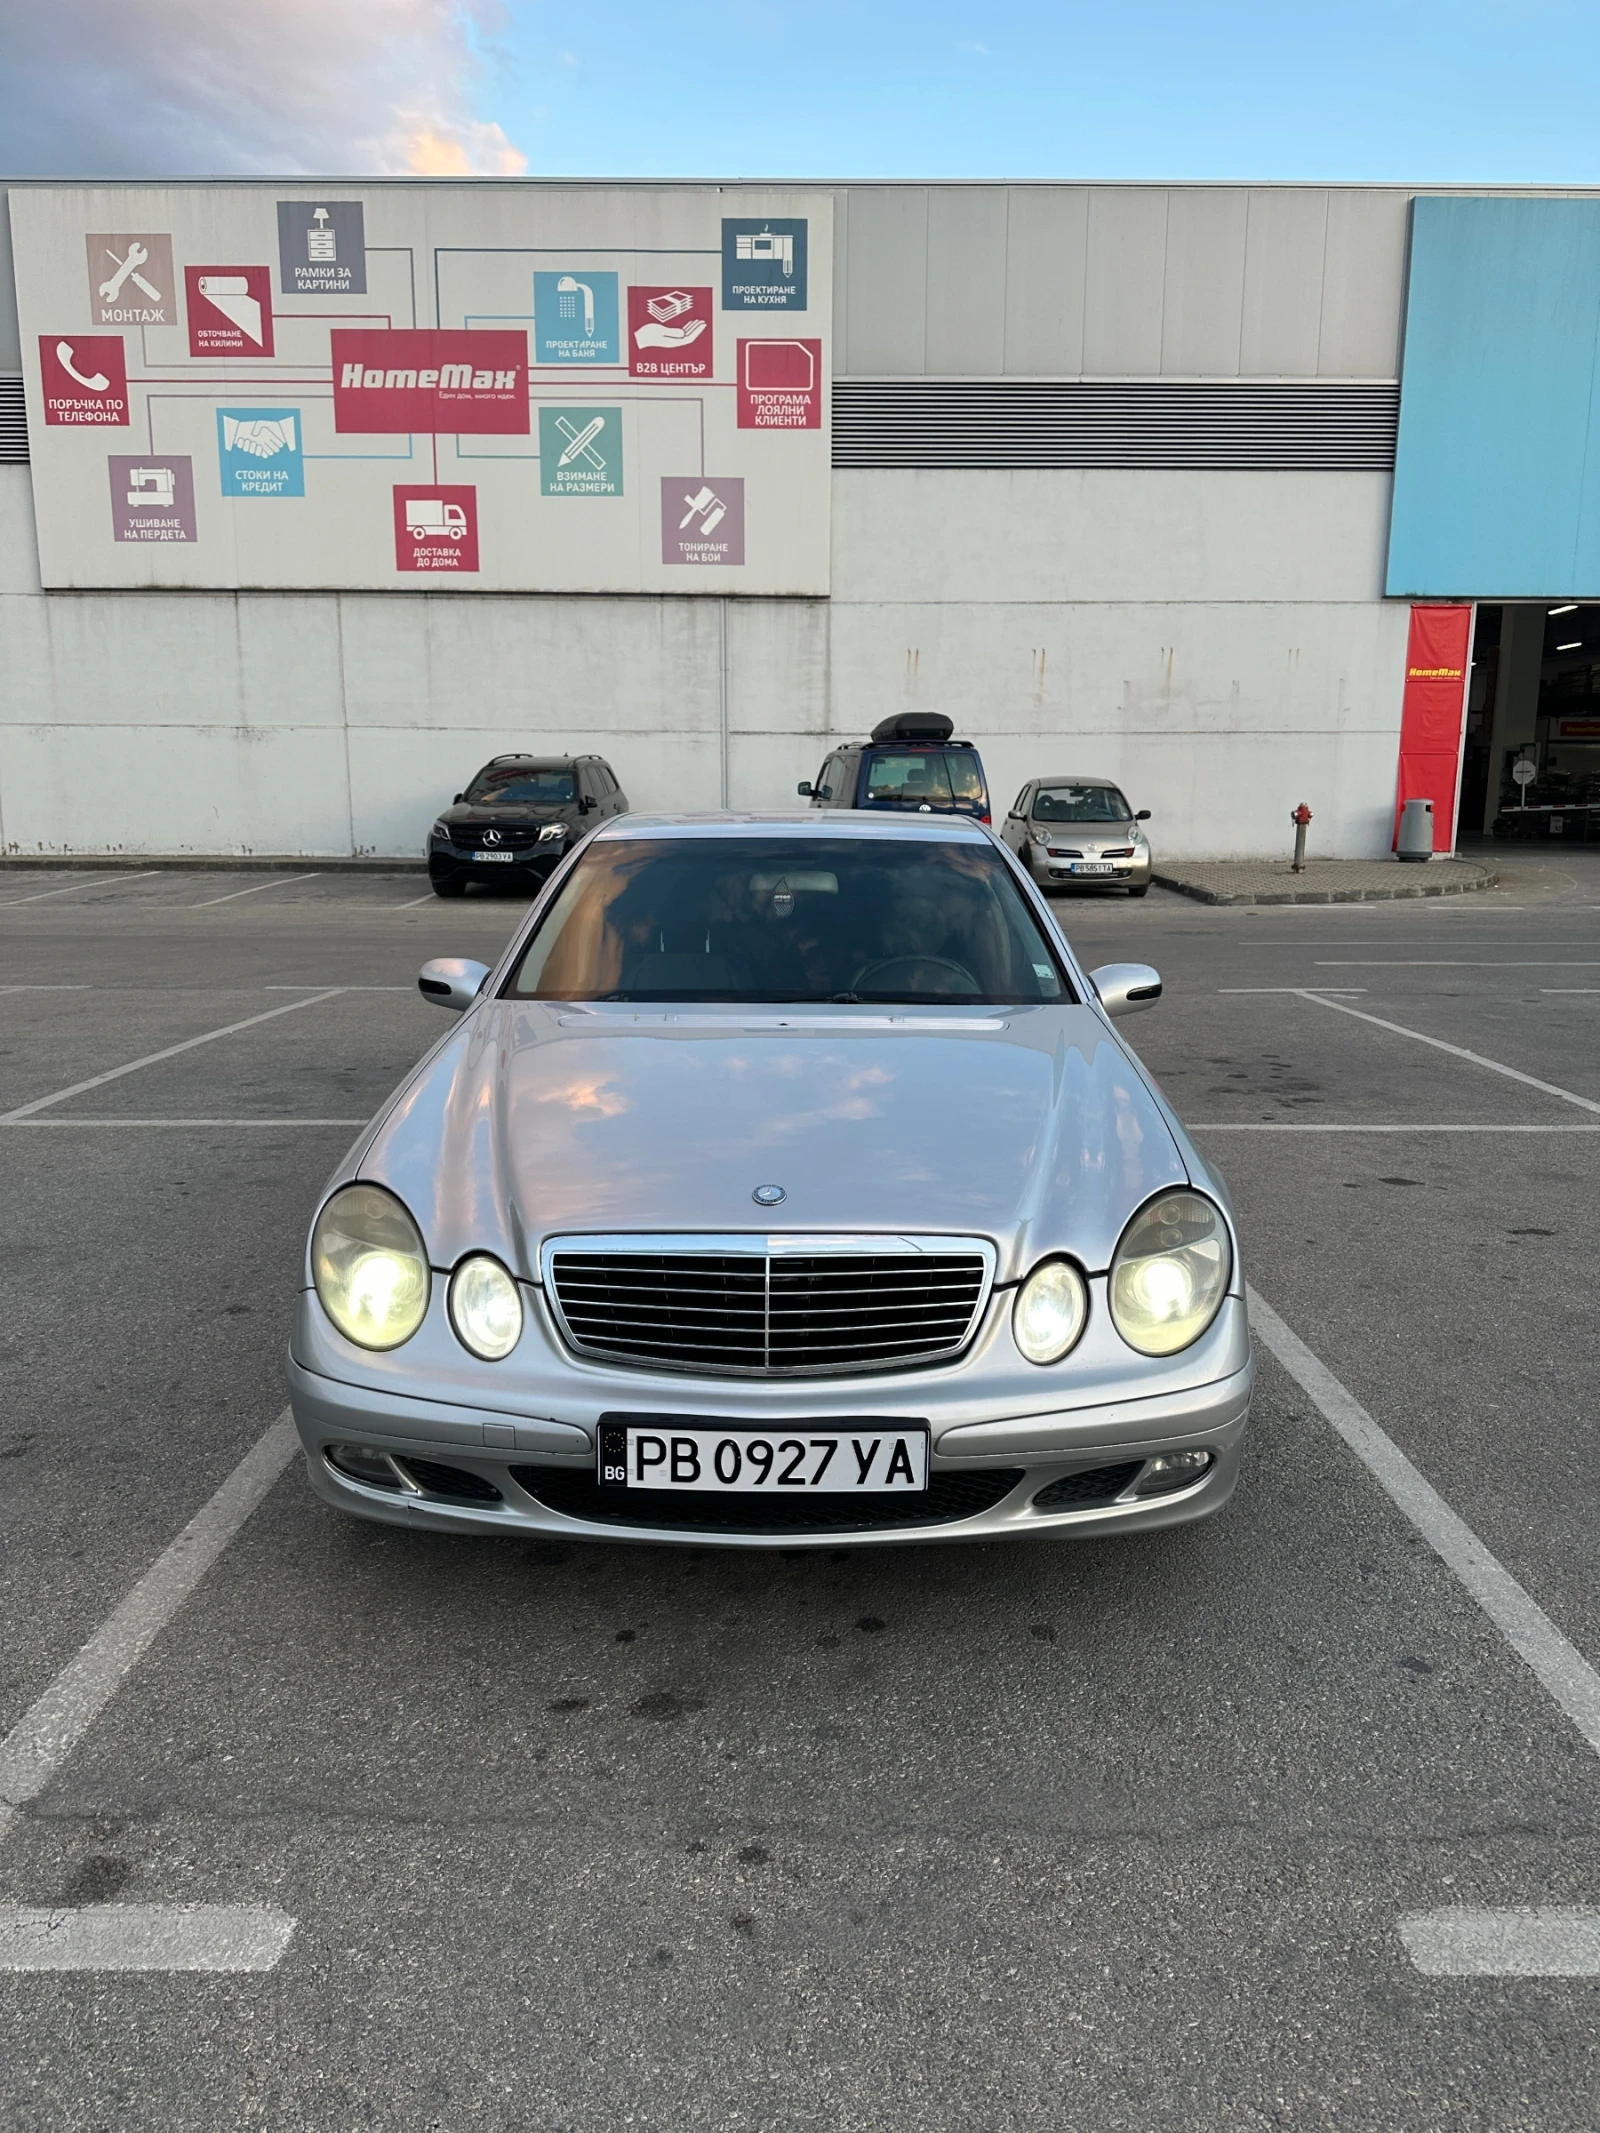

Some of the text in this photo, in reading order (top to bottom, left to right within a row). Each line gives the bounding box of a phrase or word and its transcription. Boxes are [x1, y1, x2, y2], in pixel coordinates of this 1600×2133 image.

[294, 267, 352, 278] РАМКИ ЗА
[297, 279, 350, 290] КАРТИНИ
[732, 286, 796, 295] ПРОЕКТИРАНЕ
[743, 296, 787, 304] НА КУХНЯ
[101, 309, 165, 322] МОНТАЖ
[197, 330, 242, 338] ОБТОЧВАНЕ
[198, 339, 243, 347] НА КИЛИМИ
[546, 340, 608, 349] ПРОЕКТИРАНЕ
[558, 349, 596, 358] НА БАНЯ
[636, 363, 706, 375] B2B ЦЕНТЪР
[340, 363, 516, 389] HomeMax
[48, 399, 123, 410] ПОРЪЧКА ПО
[750, 394, 811, 405] ПРОГРАМА
[756, 405, 804, 415] ЛОЯЛНИ
[57, 411, 120, 422] ТЕЛЕФОНА
[755, 416, 806, 426] КЛИЕНТИ
[235, 470, 289, 480] СТОКИ НА
[556, 472, 607, 481] ВЗИМАНЕ
[241, 482, 283, 493] КРЕДИТ
[549, 483, 615, 492] НА РАЗМЕРИ
[128, 518, 181, 528] УШИВАНЕ
[124, 530, 187, 541] НА ПЕРДЕТА
[678, 542, 729, 552] ТОНИРАНЕ
[413, 548, 461, 558] ДОСТАВКА
[686, 553, 721, 562] НА БОИ
[416, 558, 459, 567] ДО ДОМА
[636, 1435, 915, 1486] PB 0927 YA
[604, 1465, 625, 1480] BG
